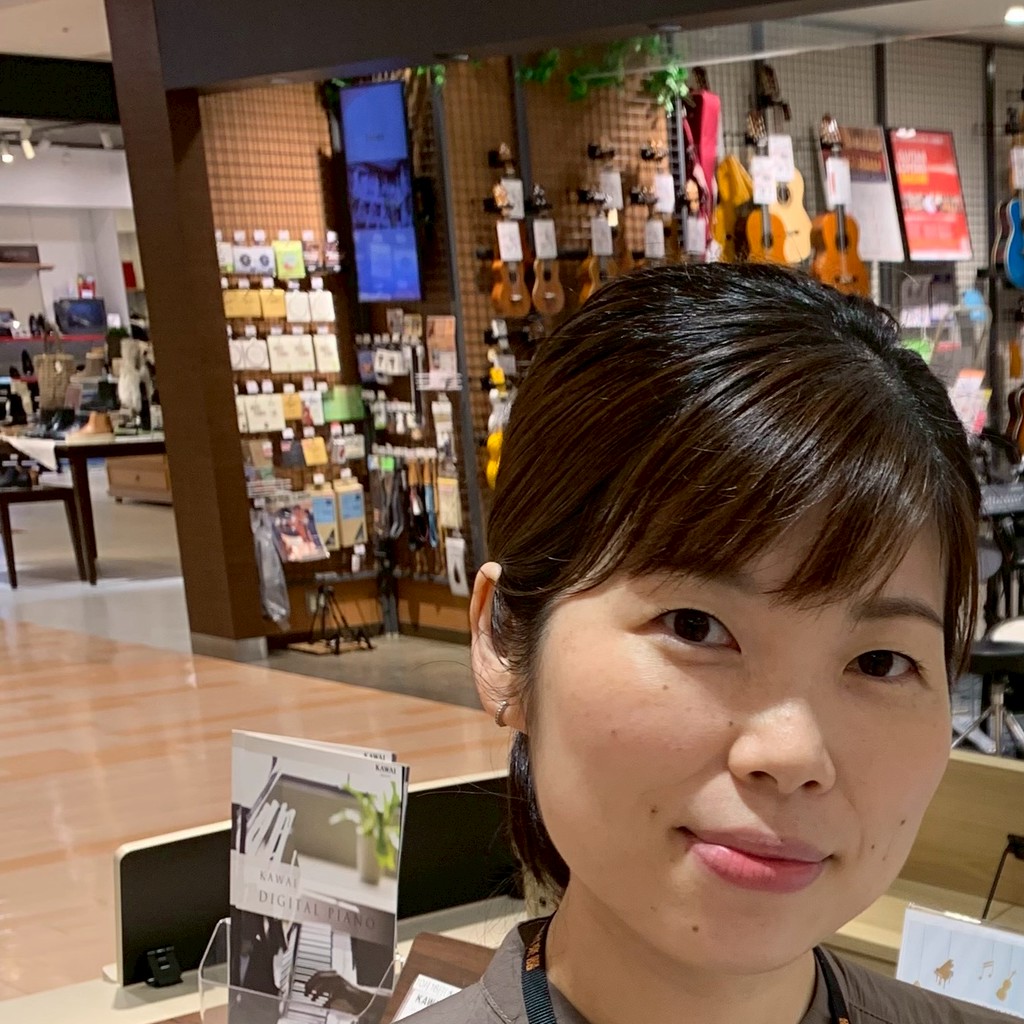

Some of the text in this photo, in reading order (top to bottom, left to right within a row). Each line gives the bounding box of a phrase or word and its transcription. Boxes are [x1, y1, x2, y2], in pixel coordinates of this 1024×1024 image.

[375, 764, 397, 775] KAWAI
[259, 869, 299, 890] KAWAI
[258, 890, 376, 930] DIGITAL PIANO
